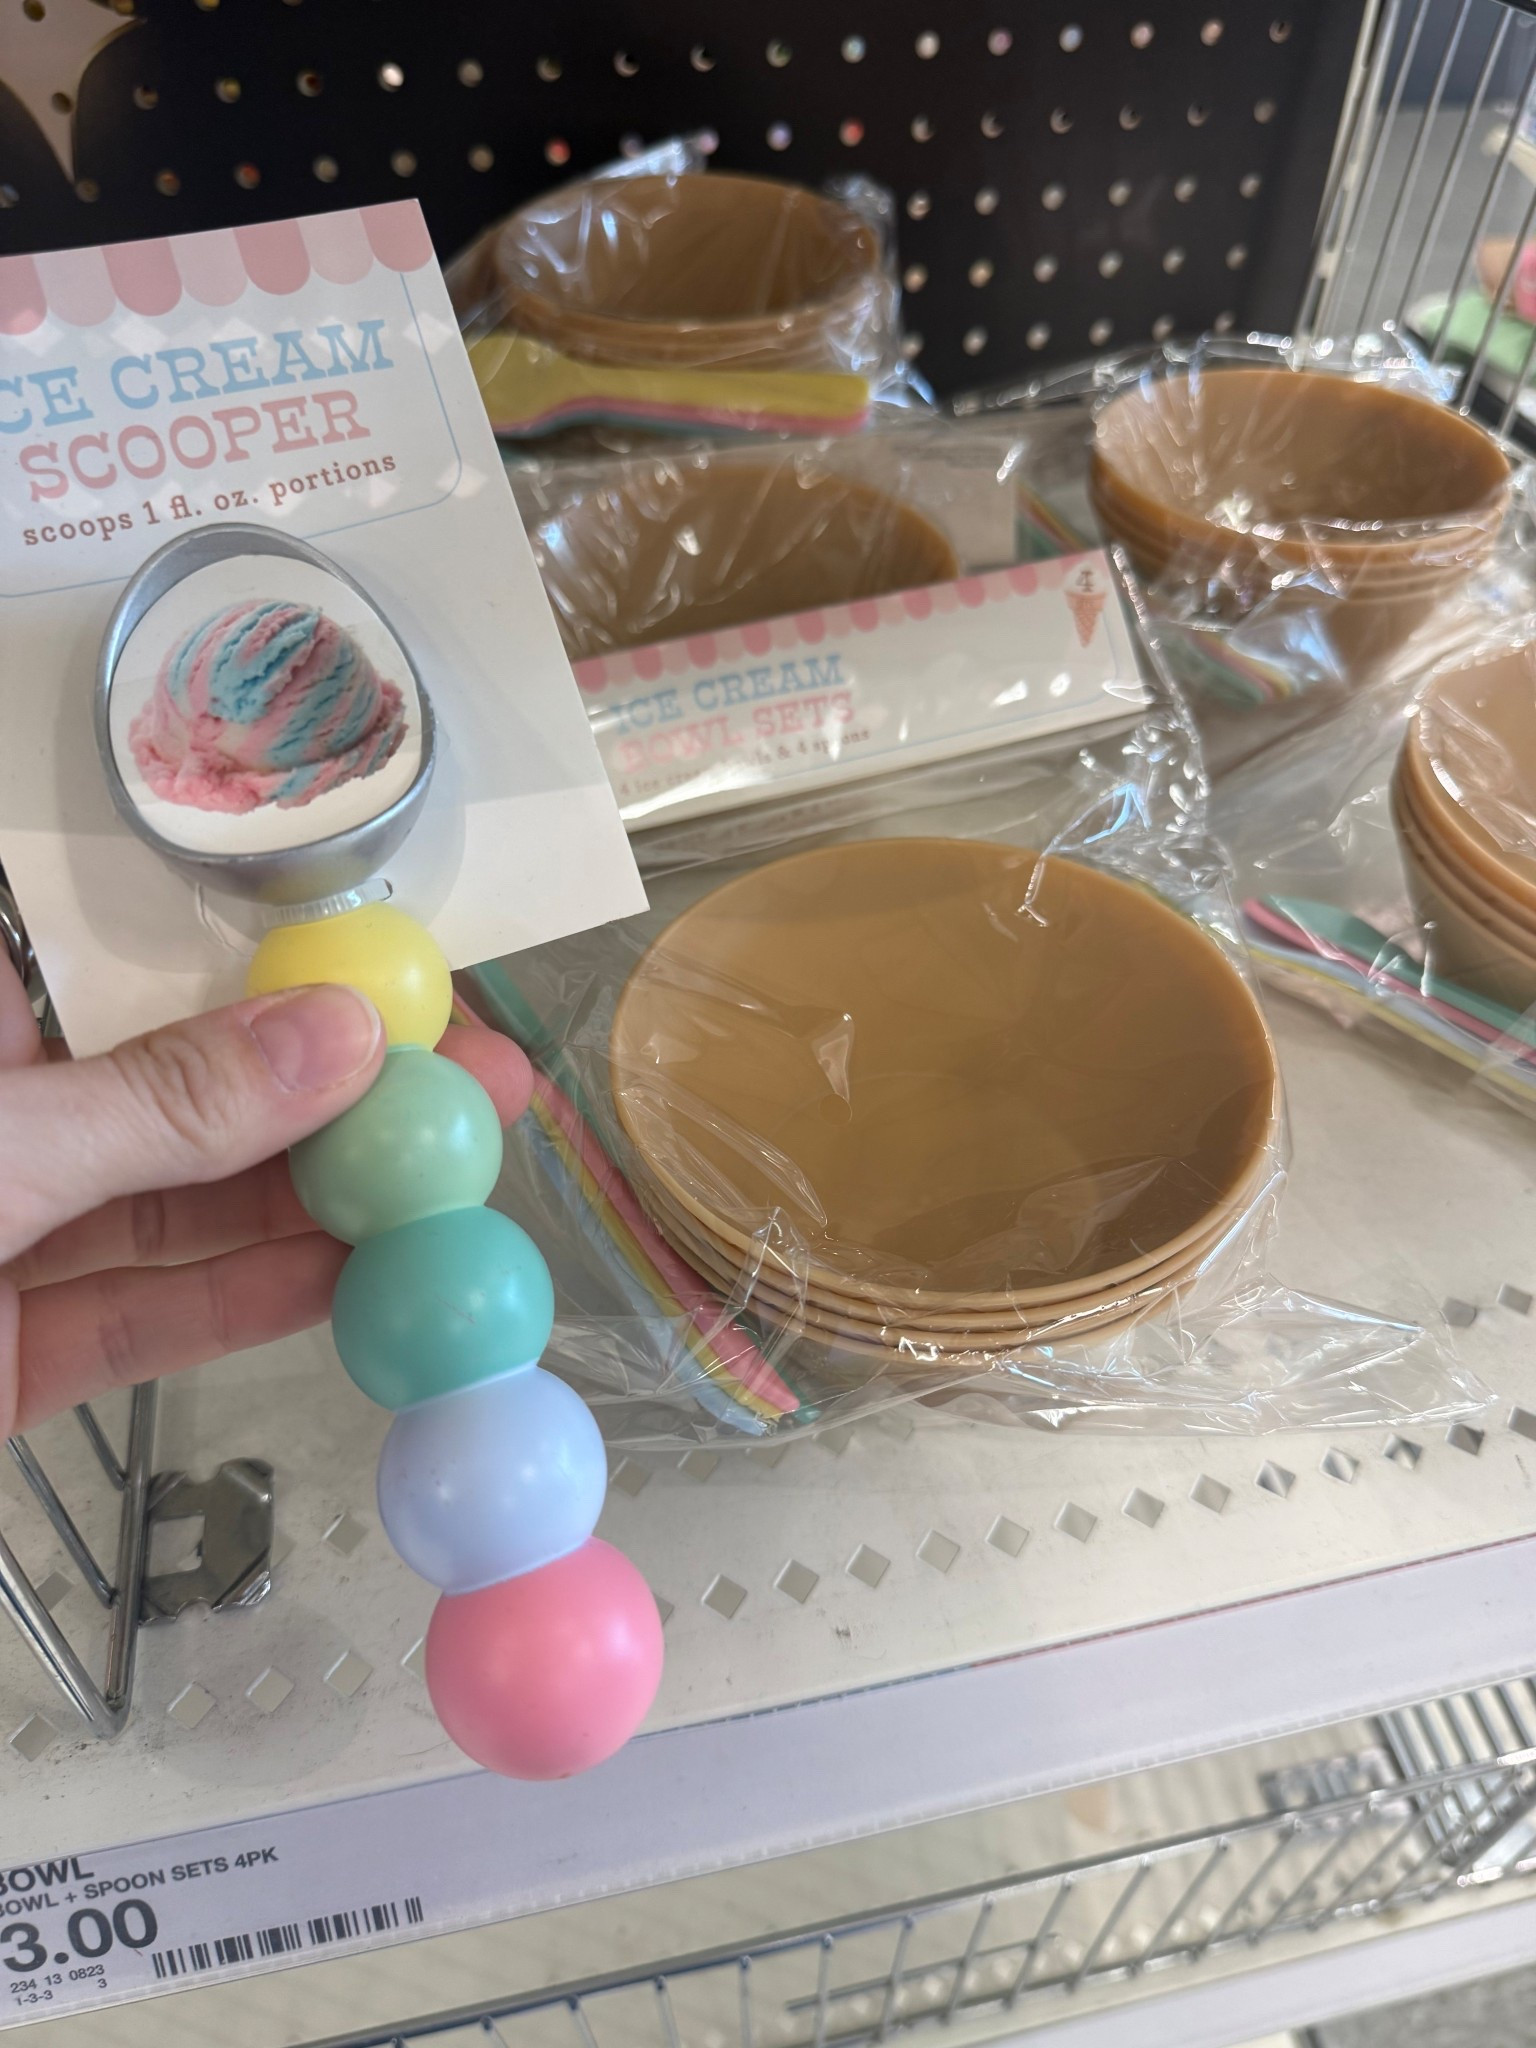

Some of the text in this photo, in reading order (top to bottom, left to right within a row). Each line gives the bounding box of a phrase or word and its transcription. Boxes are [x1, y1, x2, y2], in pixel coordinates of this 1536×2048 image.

[0, 319, 395, 434] CE CREAM
[19, 389, 371, 503] SCOOPER
[22, 454, 397, 546] scoops 1 fl. oz. portions
[610, 653, 845, 735] ICE CREAM
[617, 690, 855, 774] BOWL SETS
[812, 728, 870, 757] spons
[64, 1891, 78, 1904] +
[83, 1868, 165, 1900] SPOON
[172, 1855, 230, 1883] SETS
[235, 1846, 279, 1870] 4PK
[0, 1898, 158, 1973] 3.00
[10, 1963, 105, 1994] 234 13 0823
[17, 1977, 108, 2006] 1-3-3 3
